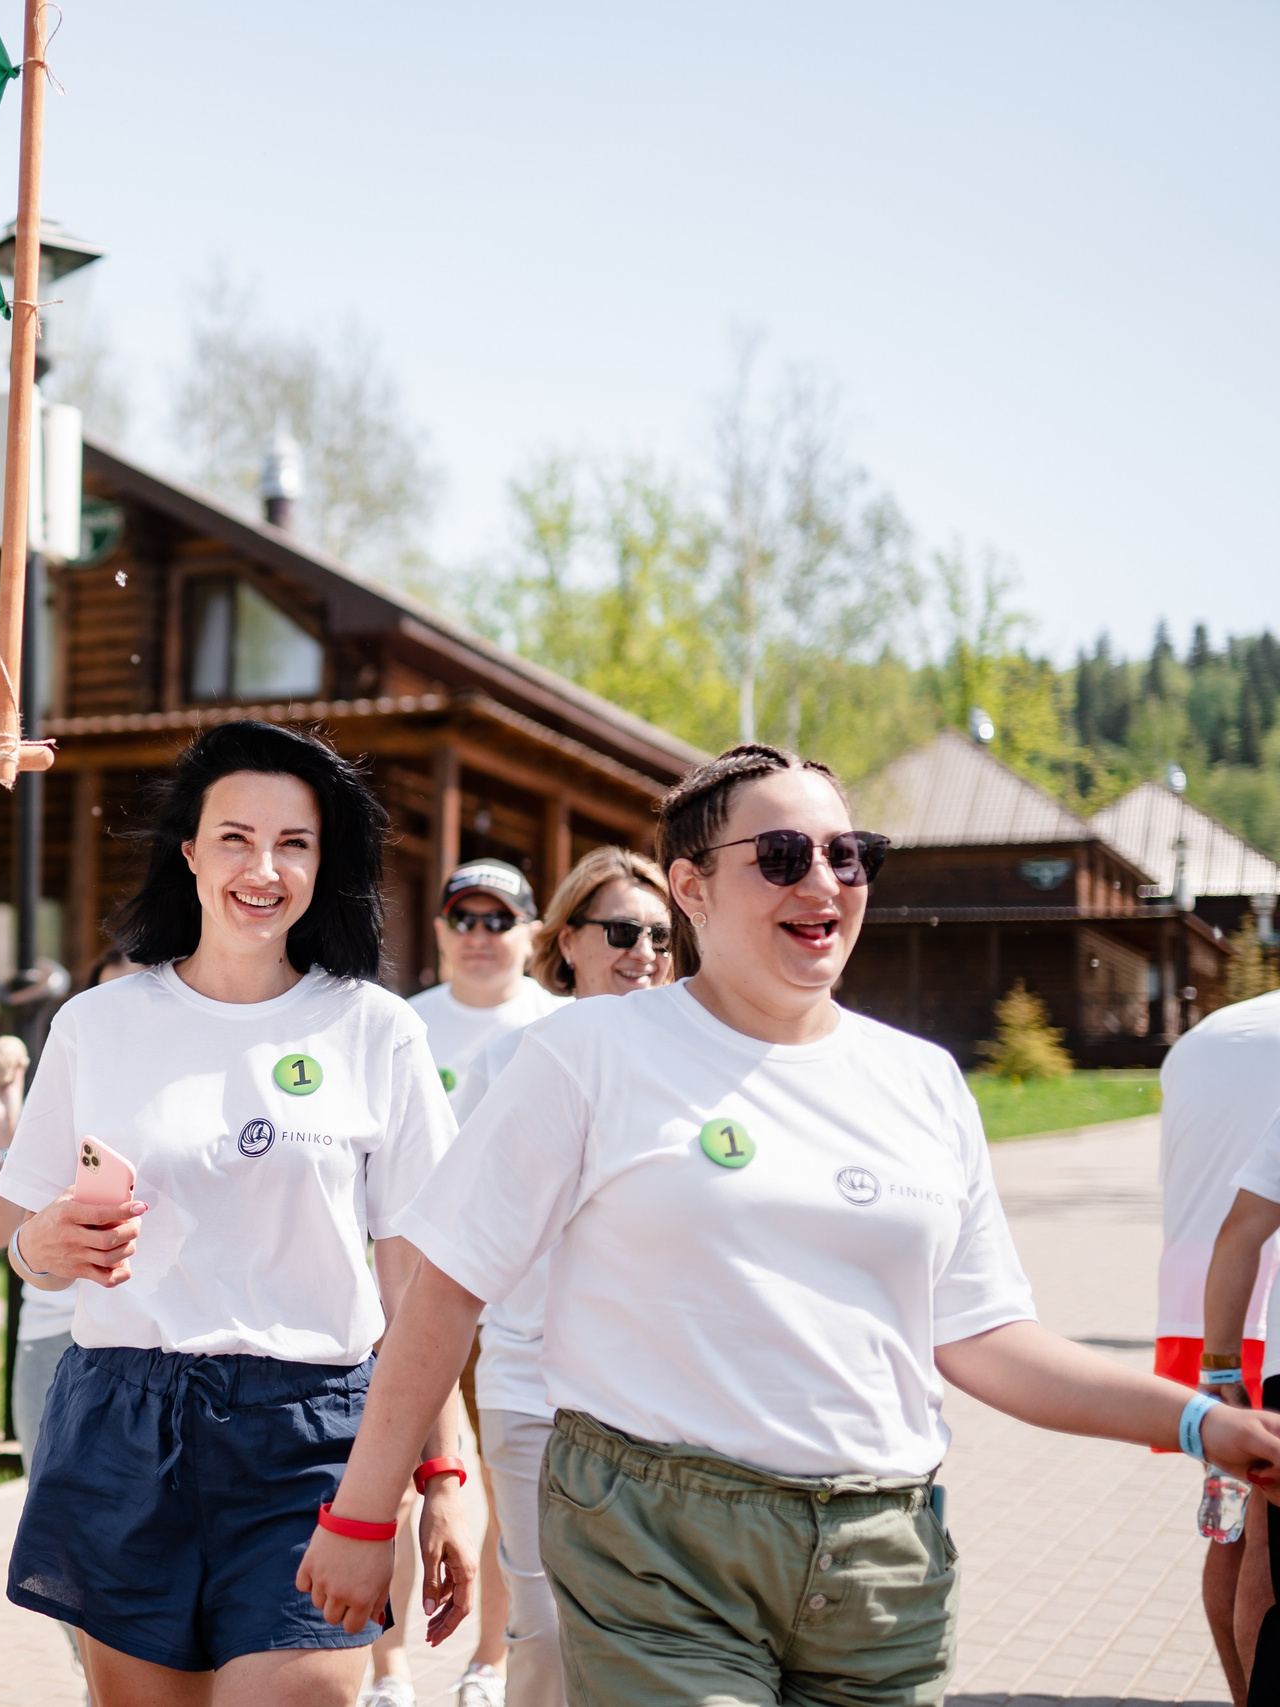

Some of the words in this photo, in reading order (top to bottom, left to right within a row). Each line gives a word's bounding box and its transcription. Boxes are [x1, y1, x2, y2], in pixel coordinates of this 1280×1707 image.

[291, 1059, 312, 1087] 1
[281, 1131, 333, 1146] FINIKO
[720, 1125, 745, 1158] 1
[889, 1184, 944, 1206] FINIKO
